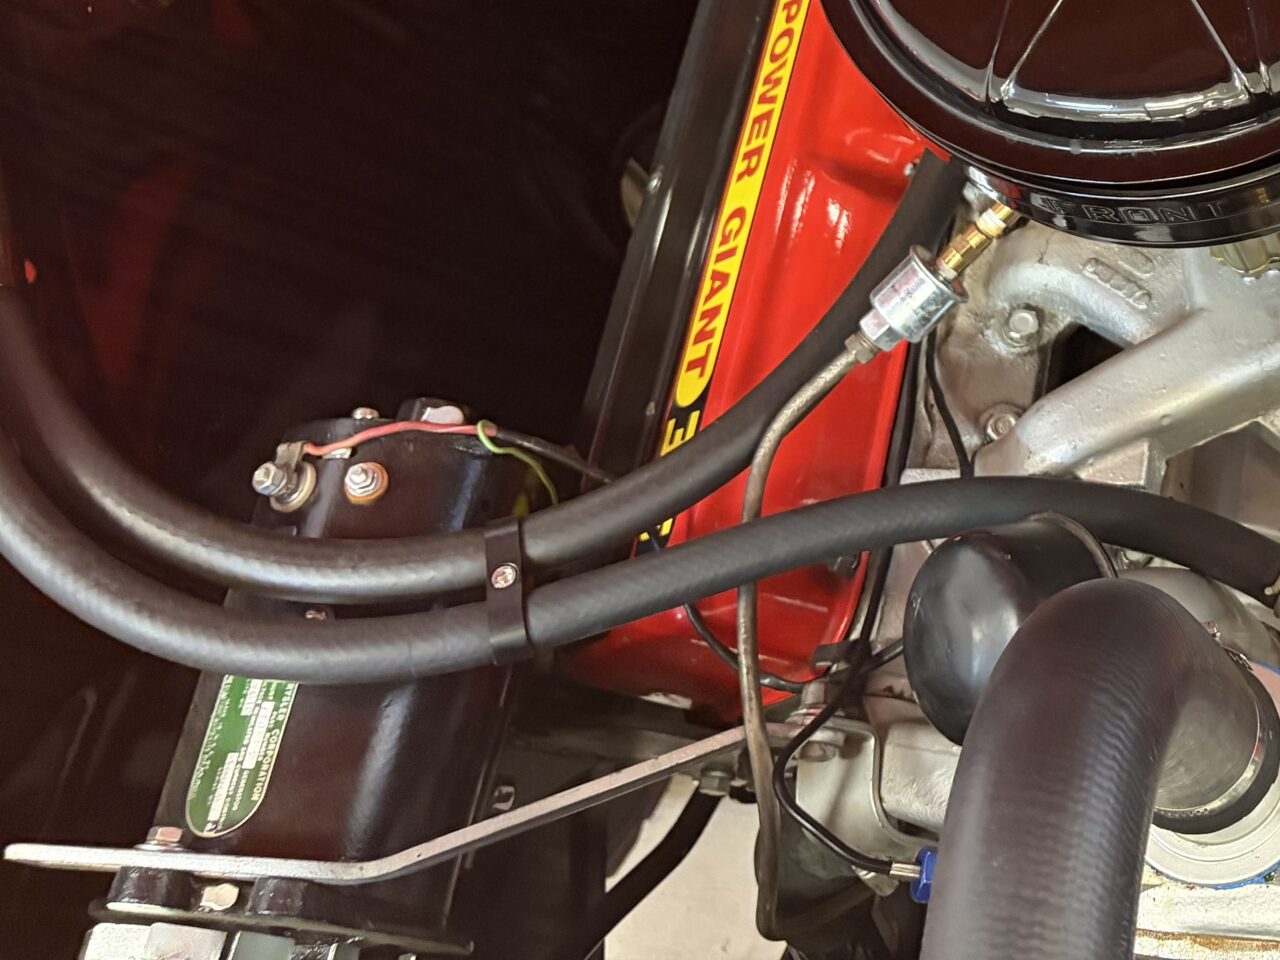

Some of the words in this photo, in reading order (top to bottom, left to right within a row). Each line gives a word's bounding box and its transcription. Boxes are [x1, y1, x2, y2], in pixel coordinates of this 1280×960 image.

[1040, 196, 1229, 225] FRONT
[685, 205, 748, 378] GIANT
[277, 682, 295, 722] RYSLER
[250, 728, 280, 802] CORPORATION
